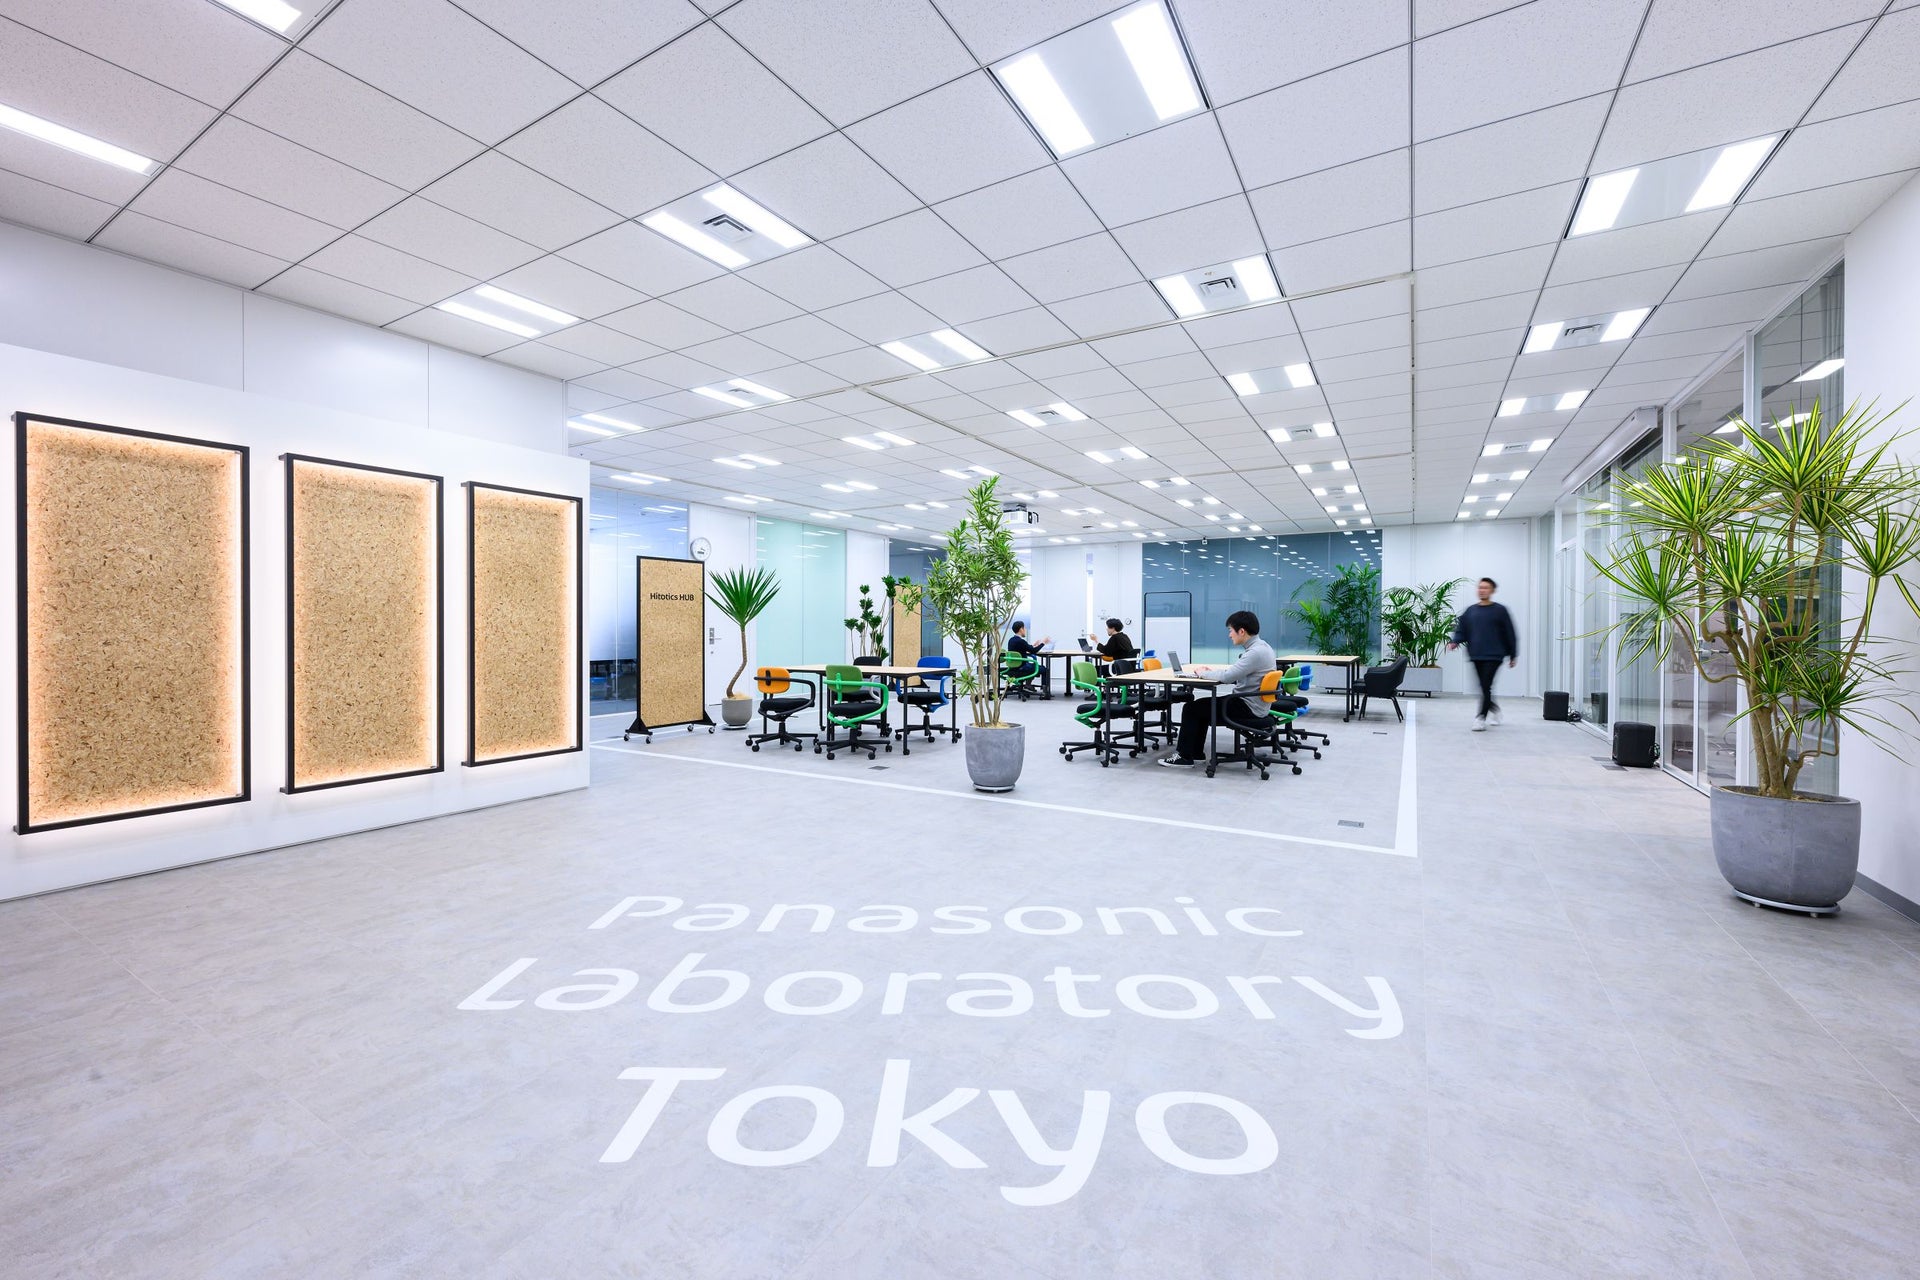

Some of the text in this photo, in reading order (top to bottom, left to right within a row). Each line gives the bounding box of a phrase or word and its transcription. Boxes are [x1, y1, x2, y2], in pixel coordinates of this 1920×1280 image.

[650, 592, 695, 601] Hitotics HUB
[588, 895, 1304, 937] Panasonic
[457, 953, 1404, 1040] Laboratory
[599, 1059, 1280, 1207] Tokyo
